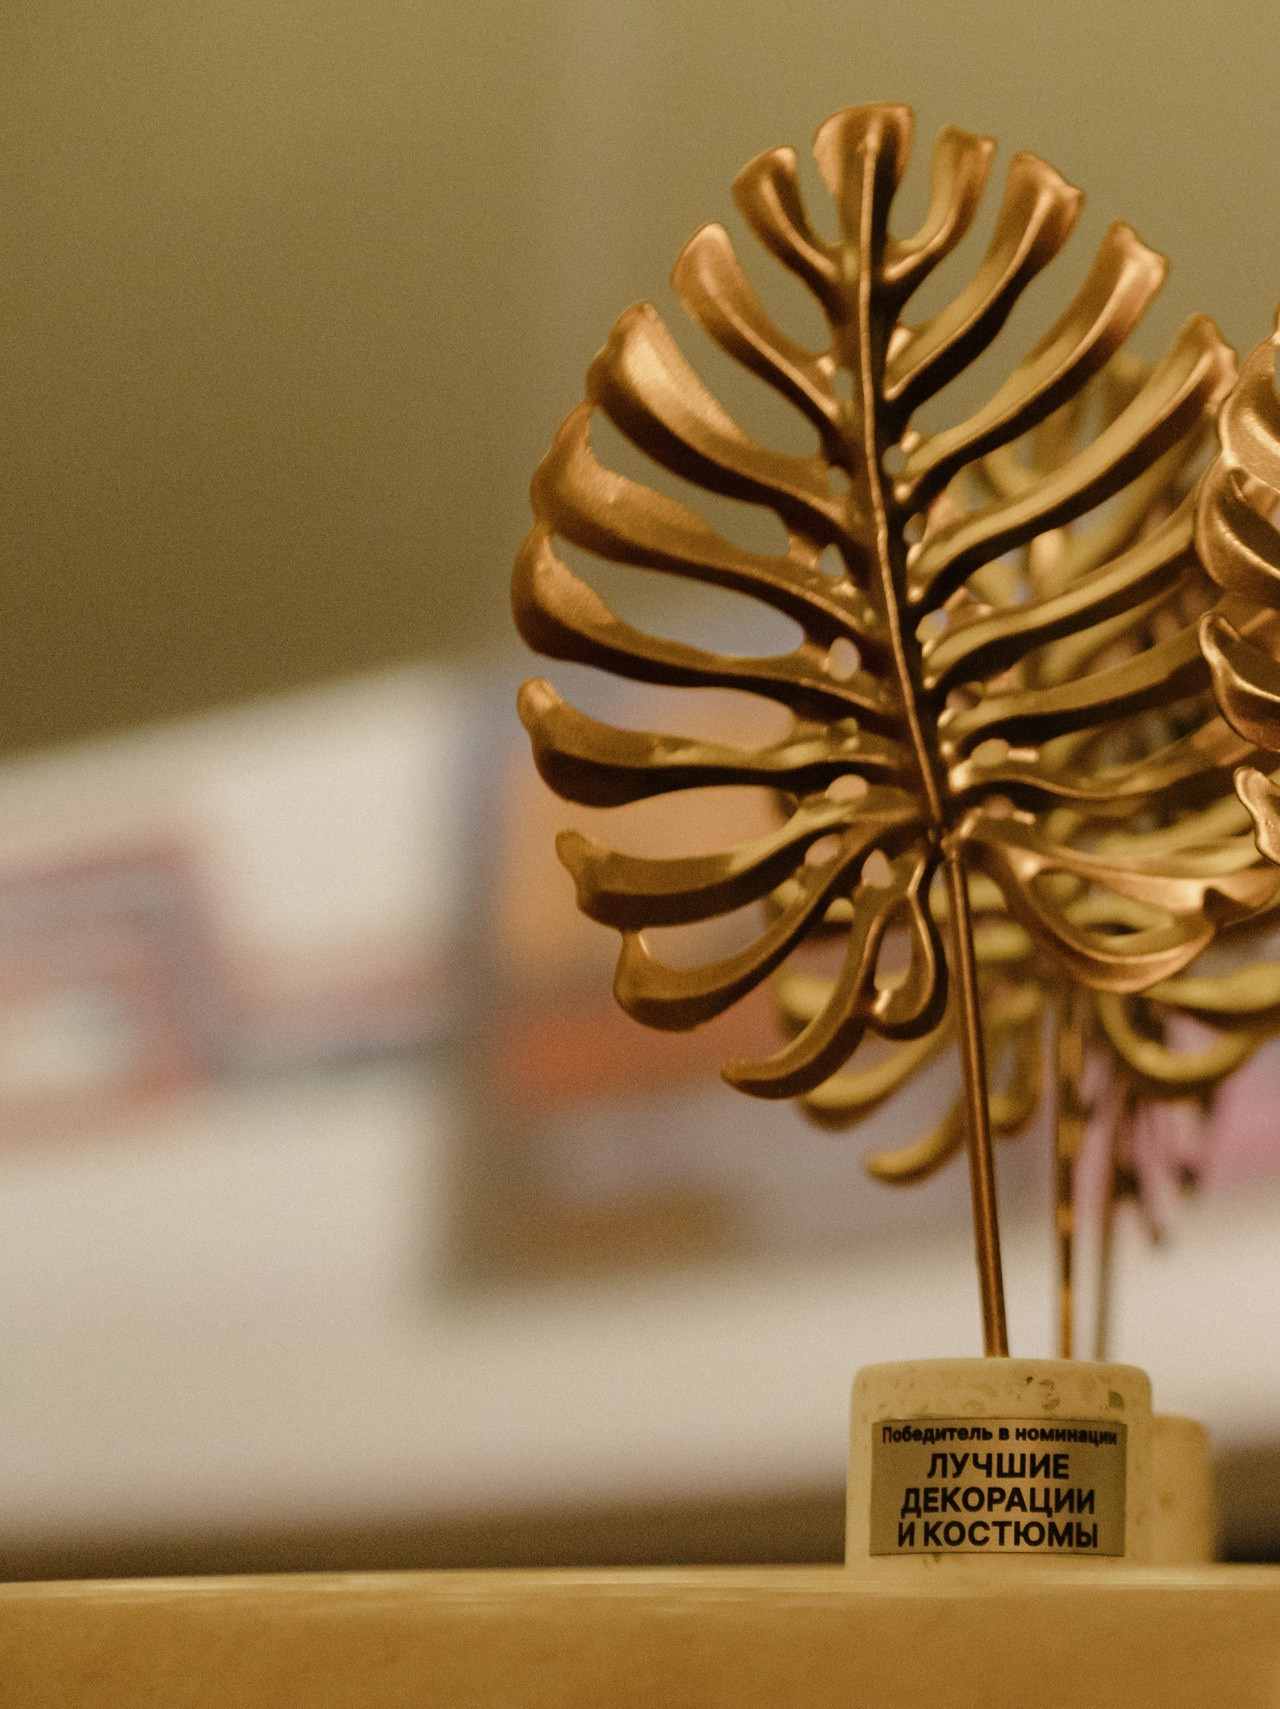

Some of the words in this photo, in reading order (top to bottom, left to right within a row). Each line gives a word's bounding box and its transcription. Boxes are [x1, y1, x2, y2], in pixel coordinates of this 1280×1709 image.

[882, 1426, 993, 1444] Победитель
[999, 1427, 1010, 1441] в
[1015, 1427, 1118, 1447] номинации
[927, 1453, 1069, 1479] ЛУЧШИЕ
[901, 1487, 1095, 1518] ДЕКОРАЦИИ
[898, 1522, 915, 1547] И
[923, 1521, 1098, 1548] КОСТЮМЫ
